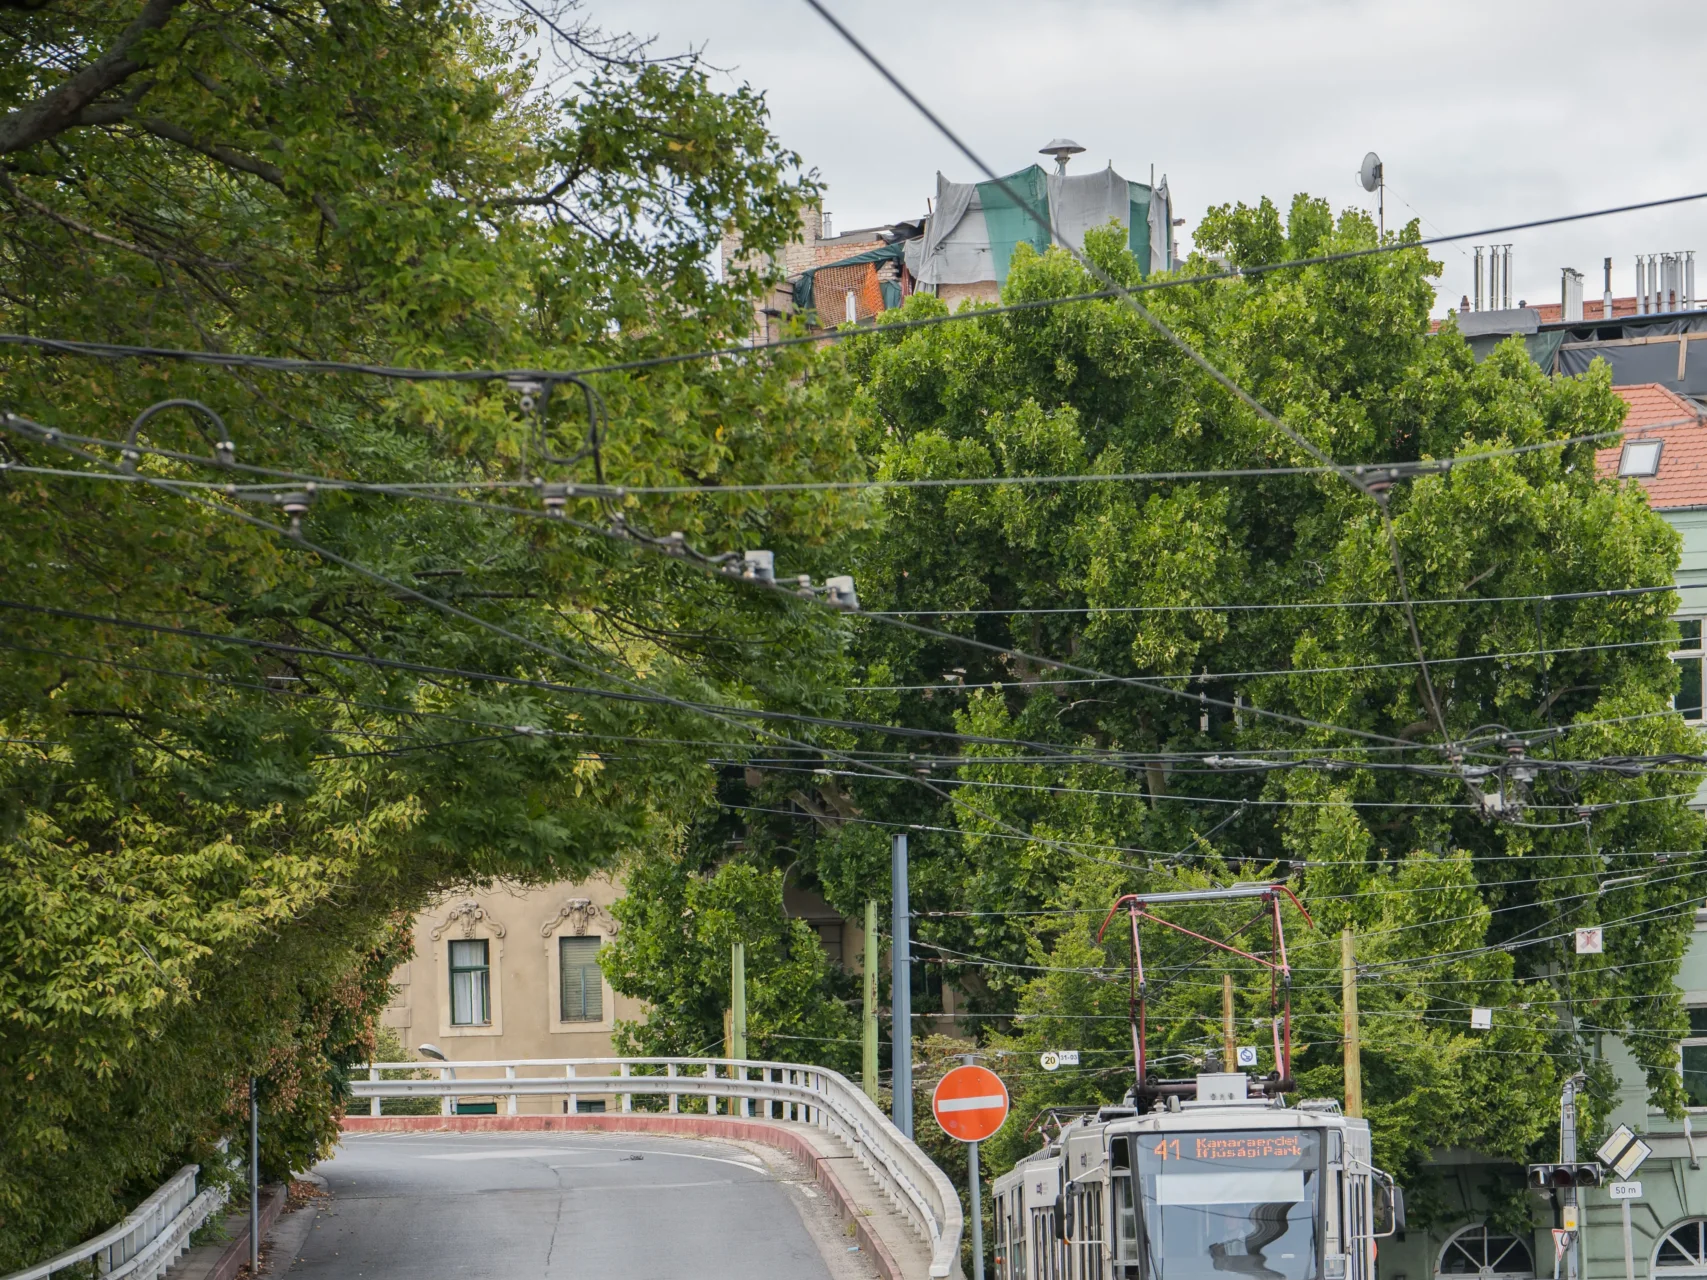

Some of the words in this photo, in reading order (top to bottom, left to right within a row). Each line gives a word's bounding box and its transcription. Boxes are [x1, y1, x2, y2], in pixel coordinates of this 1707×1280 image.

[1044, 1056, 1056, 1065] 20
[1154, 1137, 1181, 1160] 41
[1263, 1145, 1302, 1157] Park
[1615, 1186, 1626, 1195] 50
